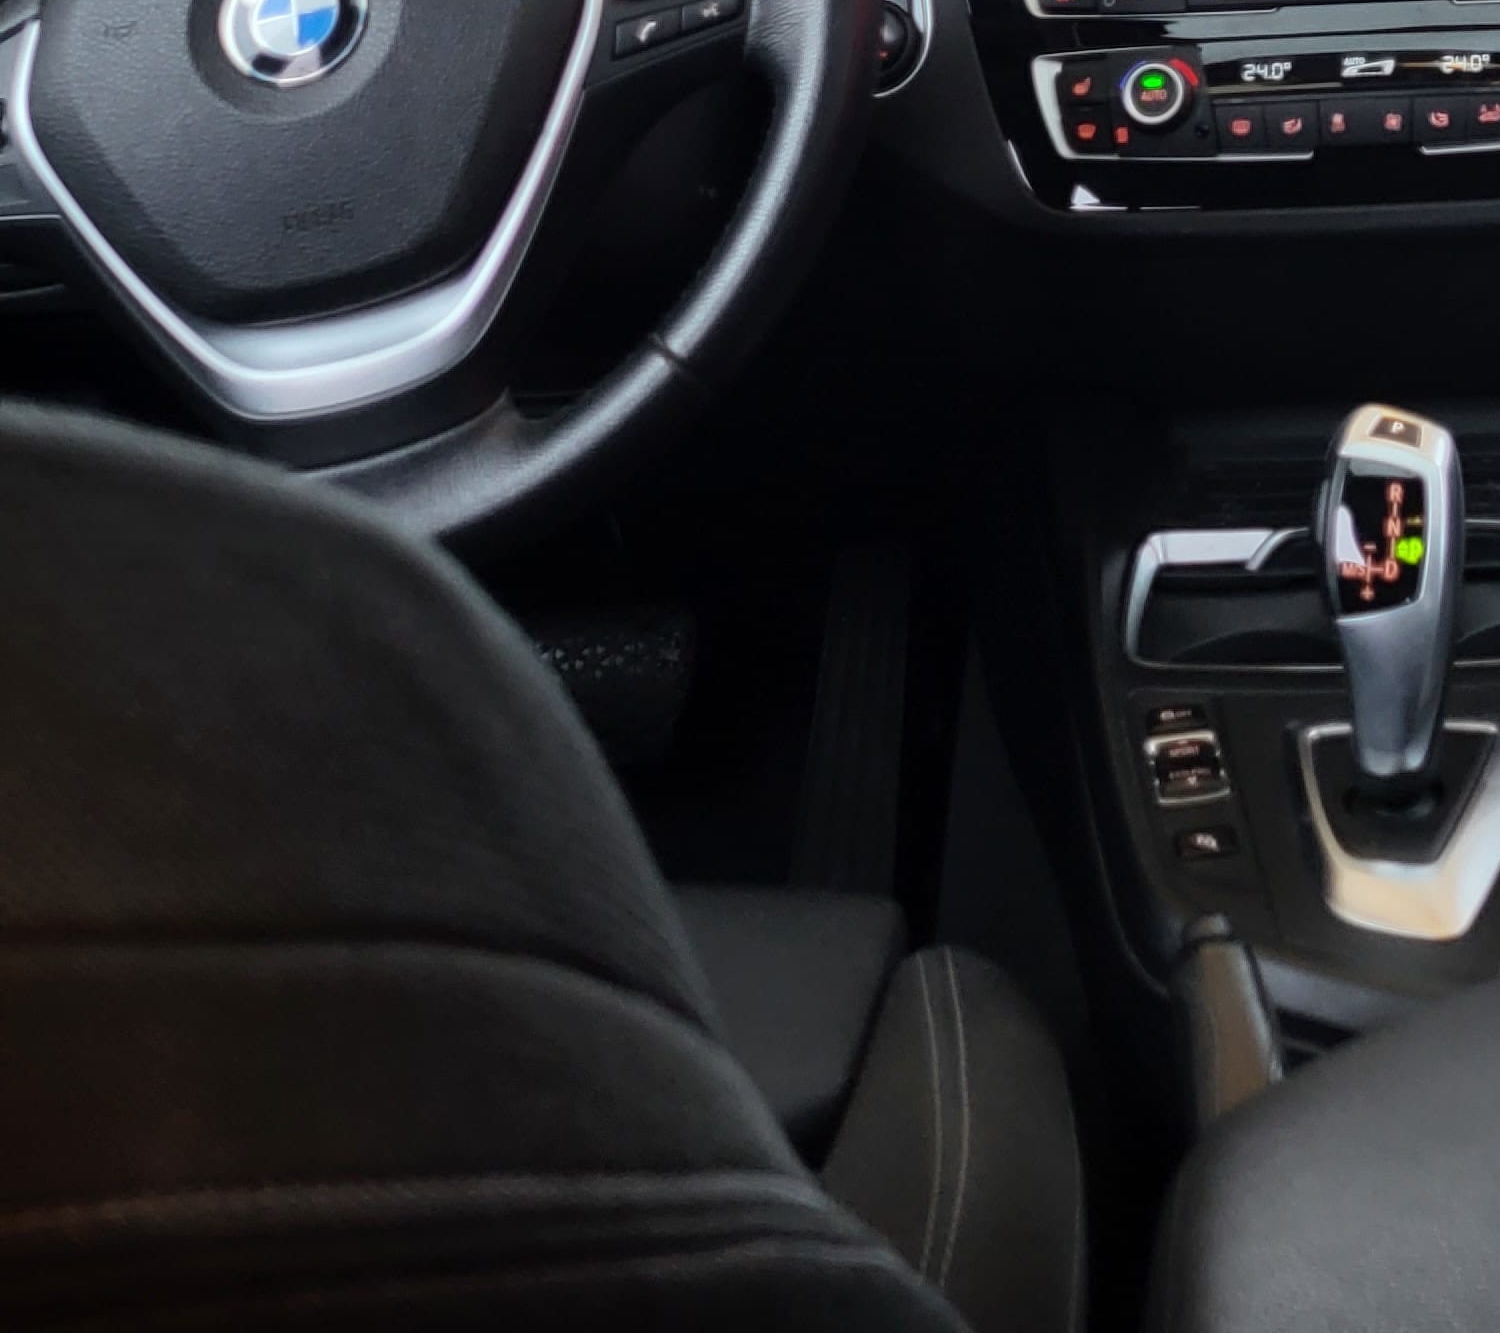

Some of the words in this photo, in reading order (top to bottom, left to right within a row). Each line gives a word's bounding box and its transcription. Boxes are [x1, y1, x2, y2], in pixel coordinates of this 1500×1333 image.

[1343, 57, 1366, 66] AUTO
[1140, 89, 1168, 102] AUTO
[1391, 420, 1405, 434] P
[1388, 482, 1404, 503] R
[1386, 518, 1401, 537] N
[1384, 561, 1399, 580] D
